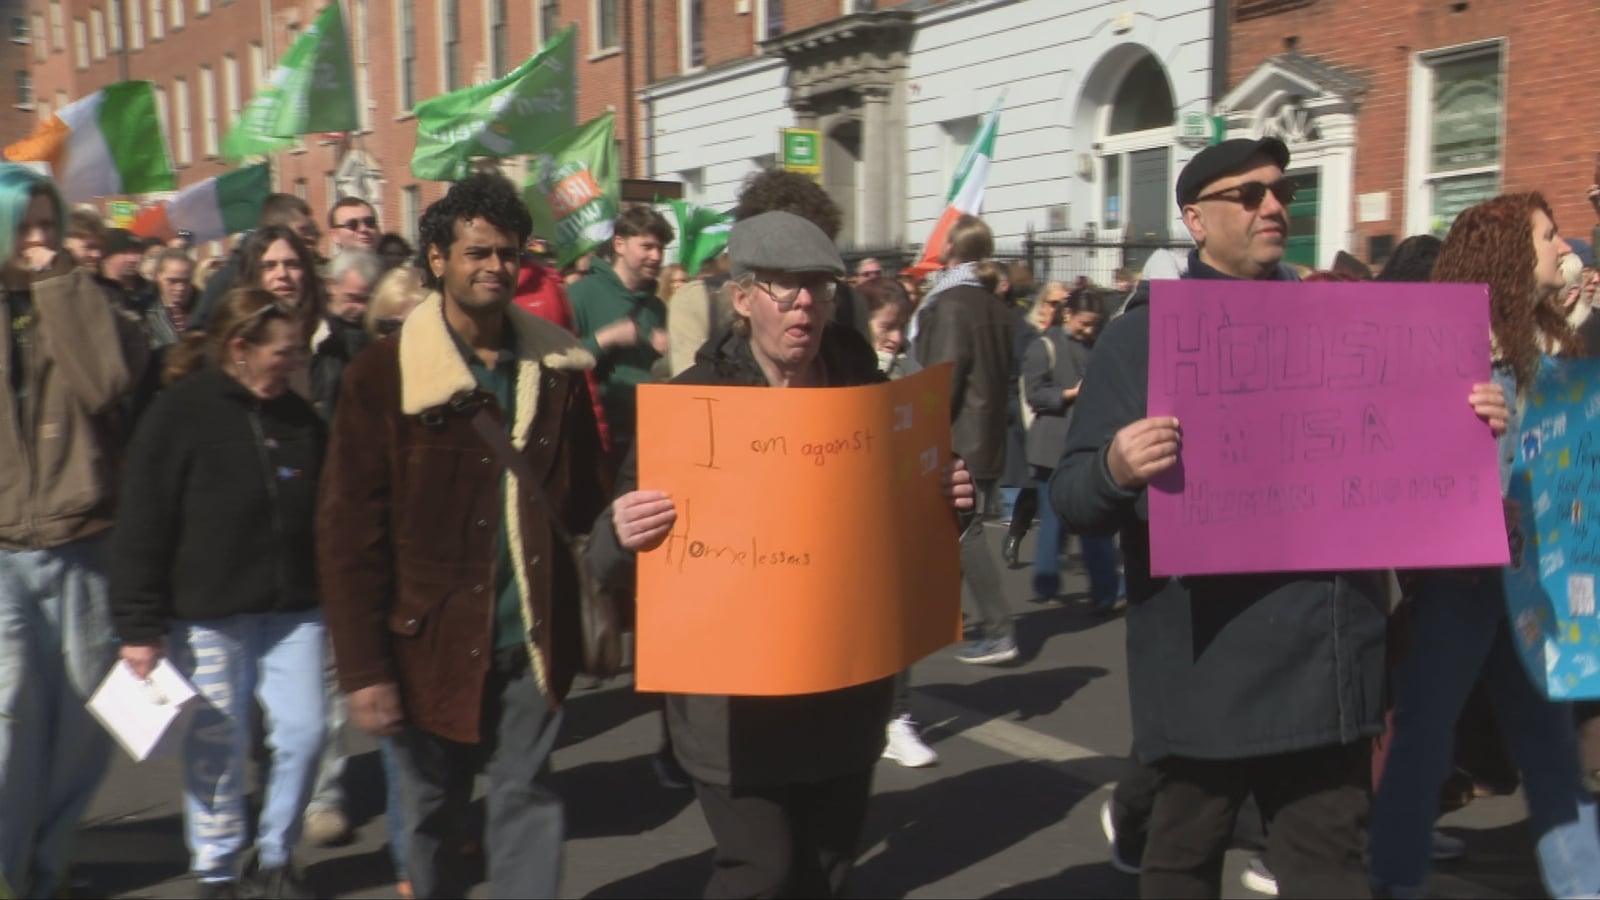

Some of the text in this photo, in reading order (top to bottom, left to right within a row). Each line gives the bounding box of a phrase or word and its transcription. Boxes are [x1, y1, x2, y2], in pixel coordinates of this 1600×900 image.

[1162, 312, 1486, 397] HOUSING
[692, 397, 721, 470] I
[751, 435, 788, 456] am
